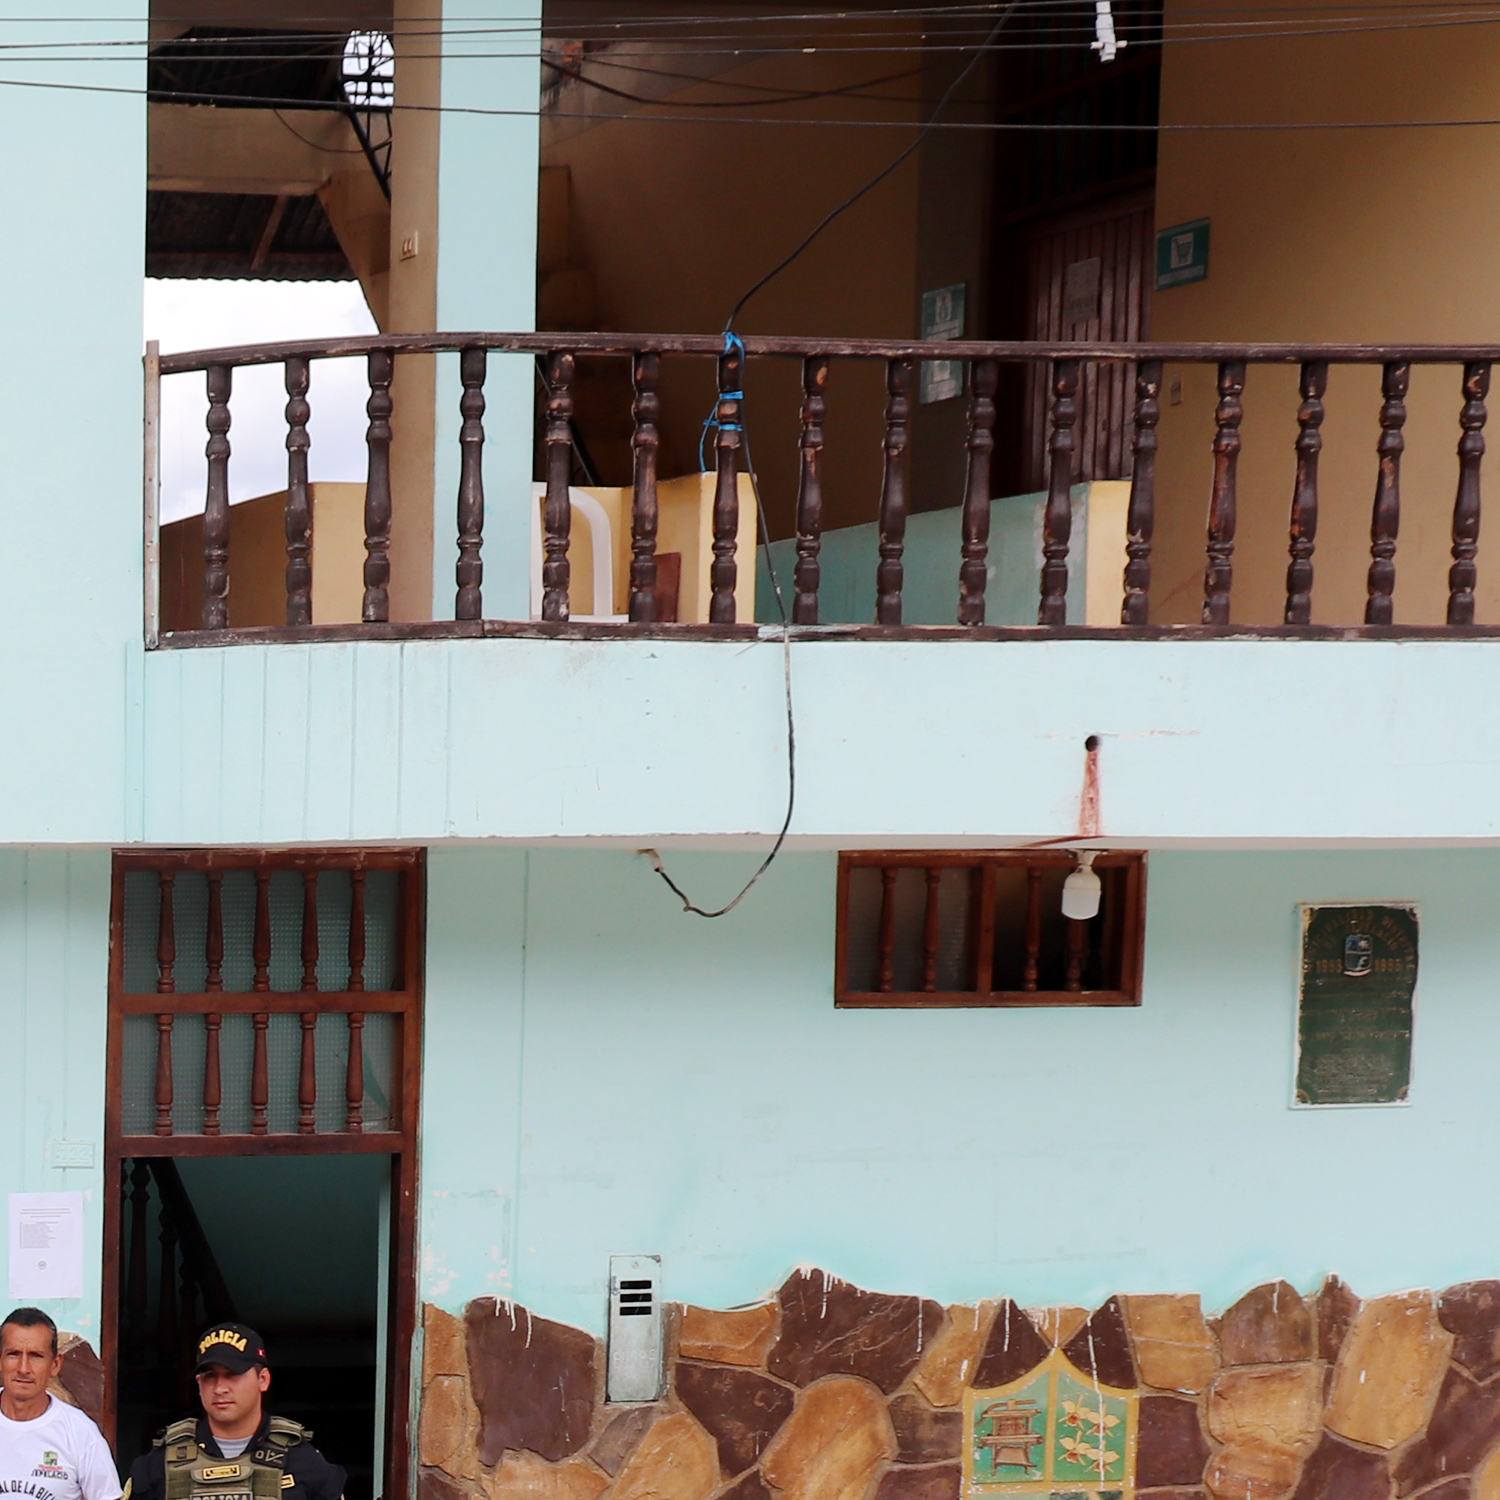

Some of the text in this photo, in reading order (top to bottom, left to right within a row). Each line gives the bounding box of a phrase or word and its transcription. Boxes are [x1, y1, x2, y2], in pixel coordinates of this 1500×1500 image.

[200, 1329, 248, 1354] POLICIA
[31, 1469, 68, 1480] JEPELACIO
[11, 1480, 22, 1493] DE
[24, 1481, 36, 1495] LA
